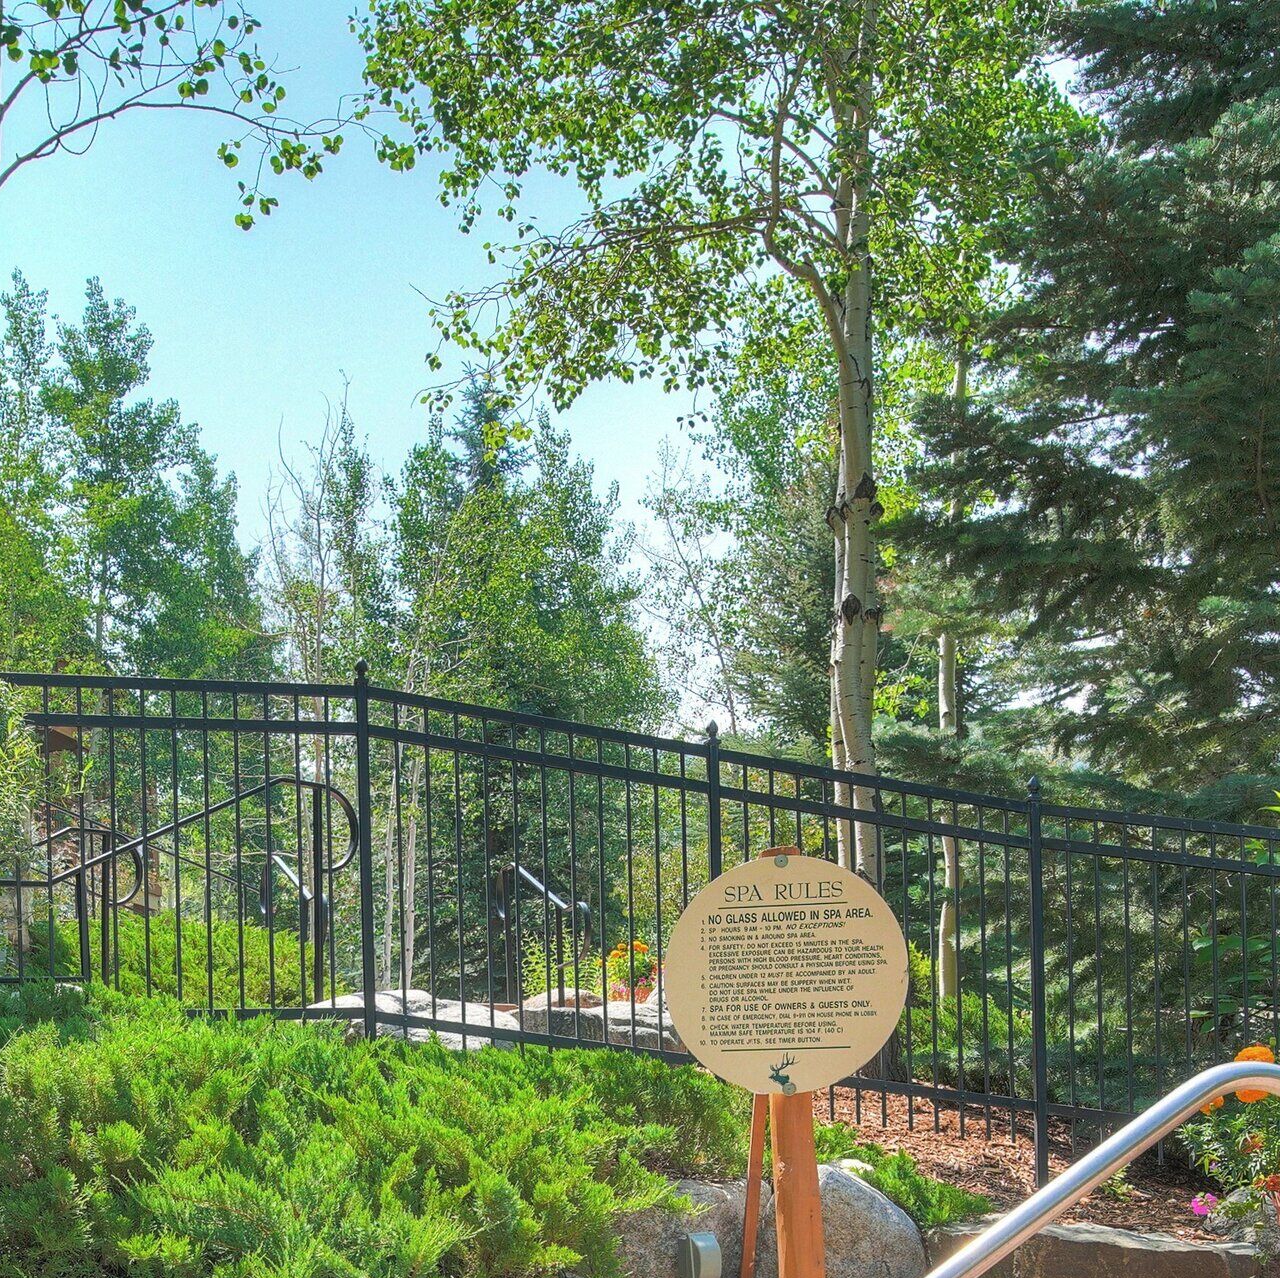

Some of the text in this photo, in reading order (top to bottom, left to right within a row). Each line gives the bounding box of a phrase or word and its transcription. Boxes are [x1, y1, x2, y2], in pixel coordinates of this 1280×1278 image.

[724, 881, 844, 903] SPA RULES
[726, 913, 758, 924] GLASS
[761, 910, 806, 922] ALLOWED
[823, 909, 842, 920] SPA
[845, 908, 873, 918] AREA.
[799, 921, 846, 929] EXCEPTIONS!
[709, 1005, 724, 1013] SPA
[726, 1004, 741, 1012] FOR
[744, 1003, 759, 1011] USE
[775, 1002, 807, 1010] OWNERS
[818, 1001, 849, 1009] GUESTS
[851, 1000, 873, 1008] ONLY.
